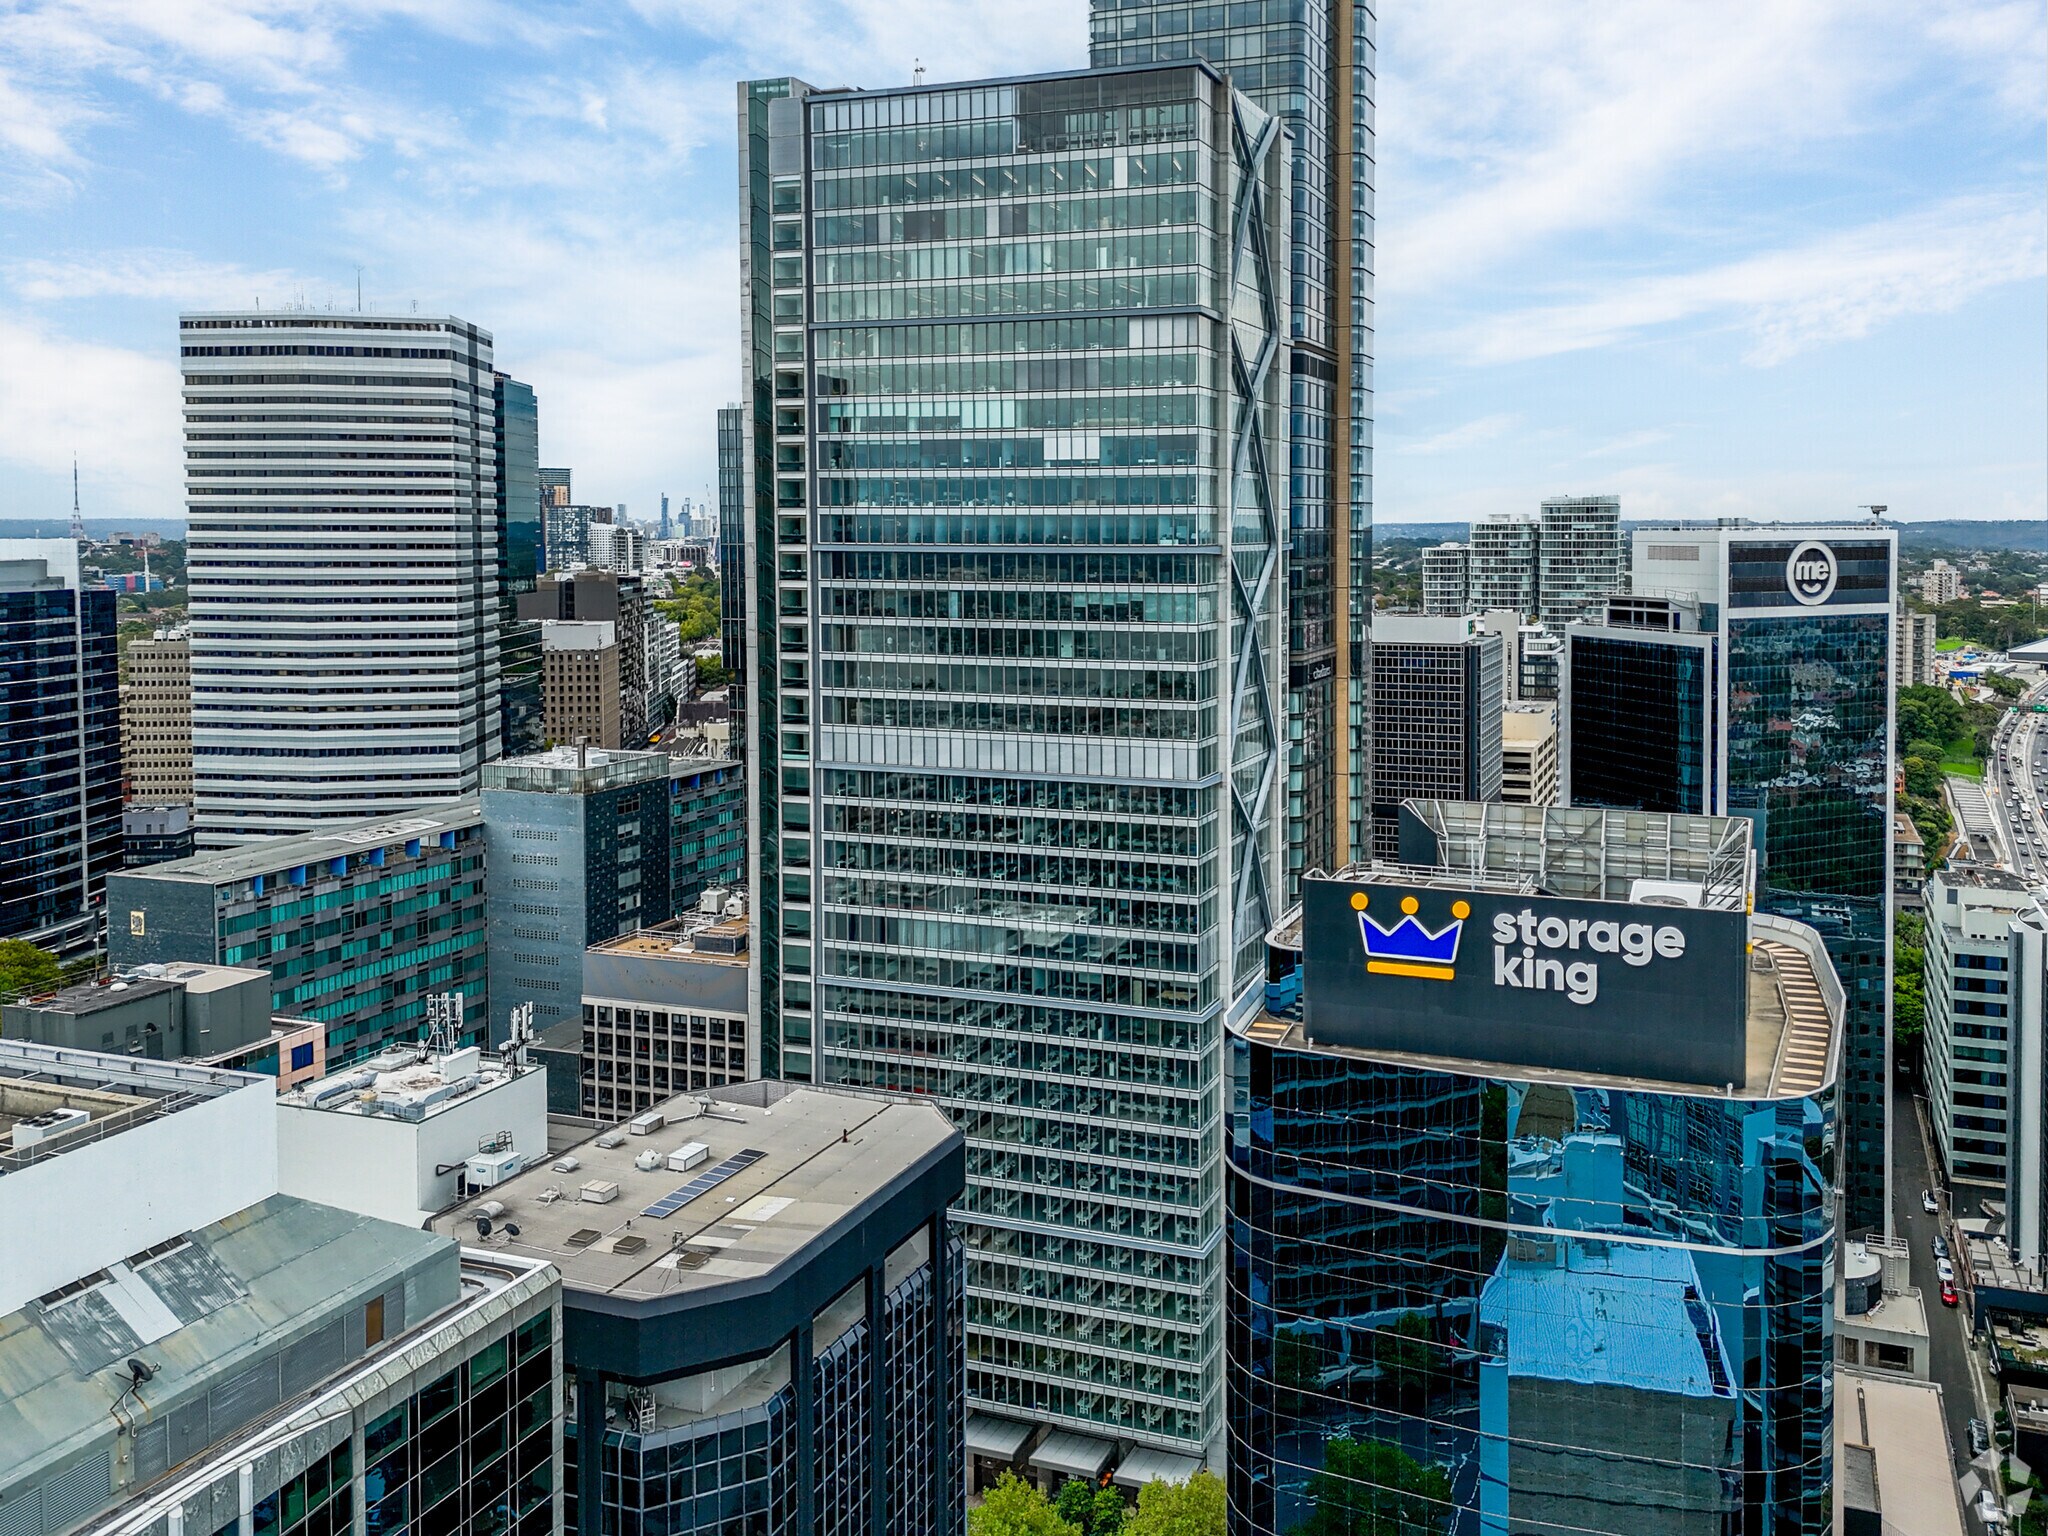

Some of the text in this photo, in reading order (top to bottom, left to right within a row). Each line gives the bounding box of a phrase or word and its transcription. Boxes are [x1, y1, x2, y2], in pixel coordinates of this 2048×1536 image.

[1796, 561, 1829, 580] me
[1492, 908, 1686, 966] storage
[1494, 945, 1598, 1005] king
